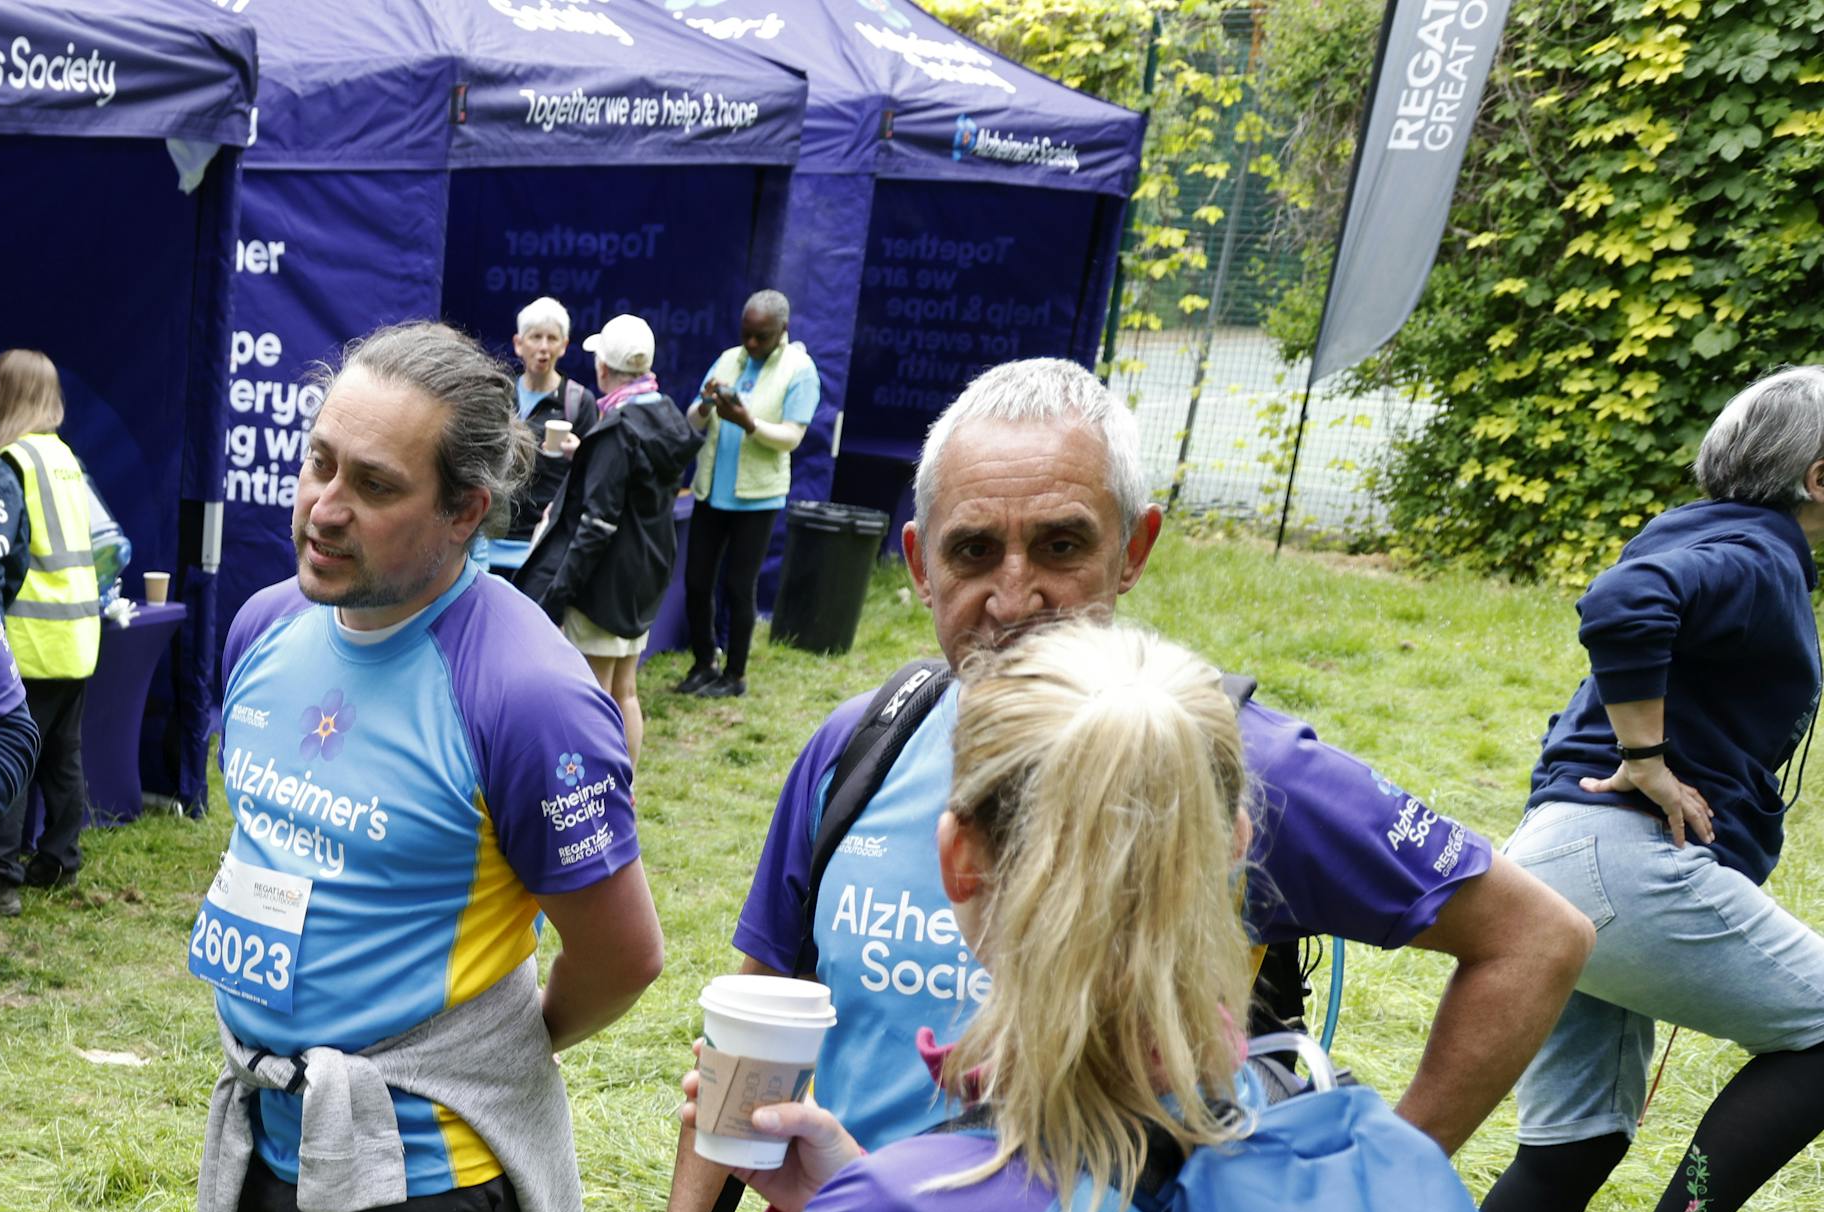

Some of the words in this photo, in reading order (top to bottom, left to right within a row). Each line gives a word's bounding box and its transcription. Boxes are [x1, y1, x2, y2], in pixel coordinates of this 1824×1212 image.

[8, 37, 117, 107] Society
[519, 88, 606, 132] Together
[605, 98, 630, 126] we
[631, 97, 658, 126] are
[660, 91, 701, 133] help
[702, 92, 717, 127] &
[717, 94, 758, 132] hope
[1423, 36, 1477, 151] GREAT
[225, 748, 389, 841] Alzheimer's
[238, 794, 345, 879] Society
[191, 910, 292, 991] 26023
[832, 884, 966, 946] Alzhe
